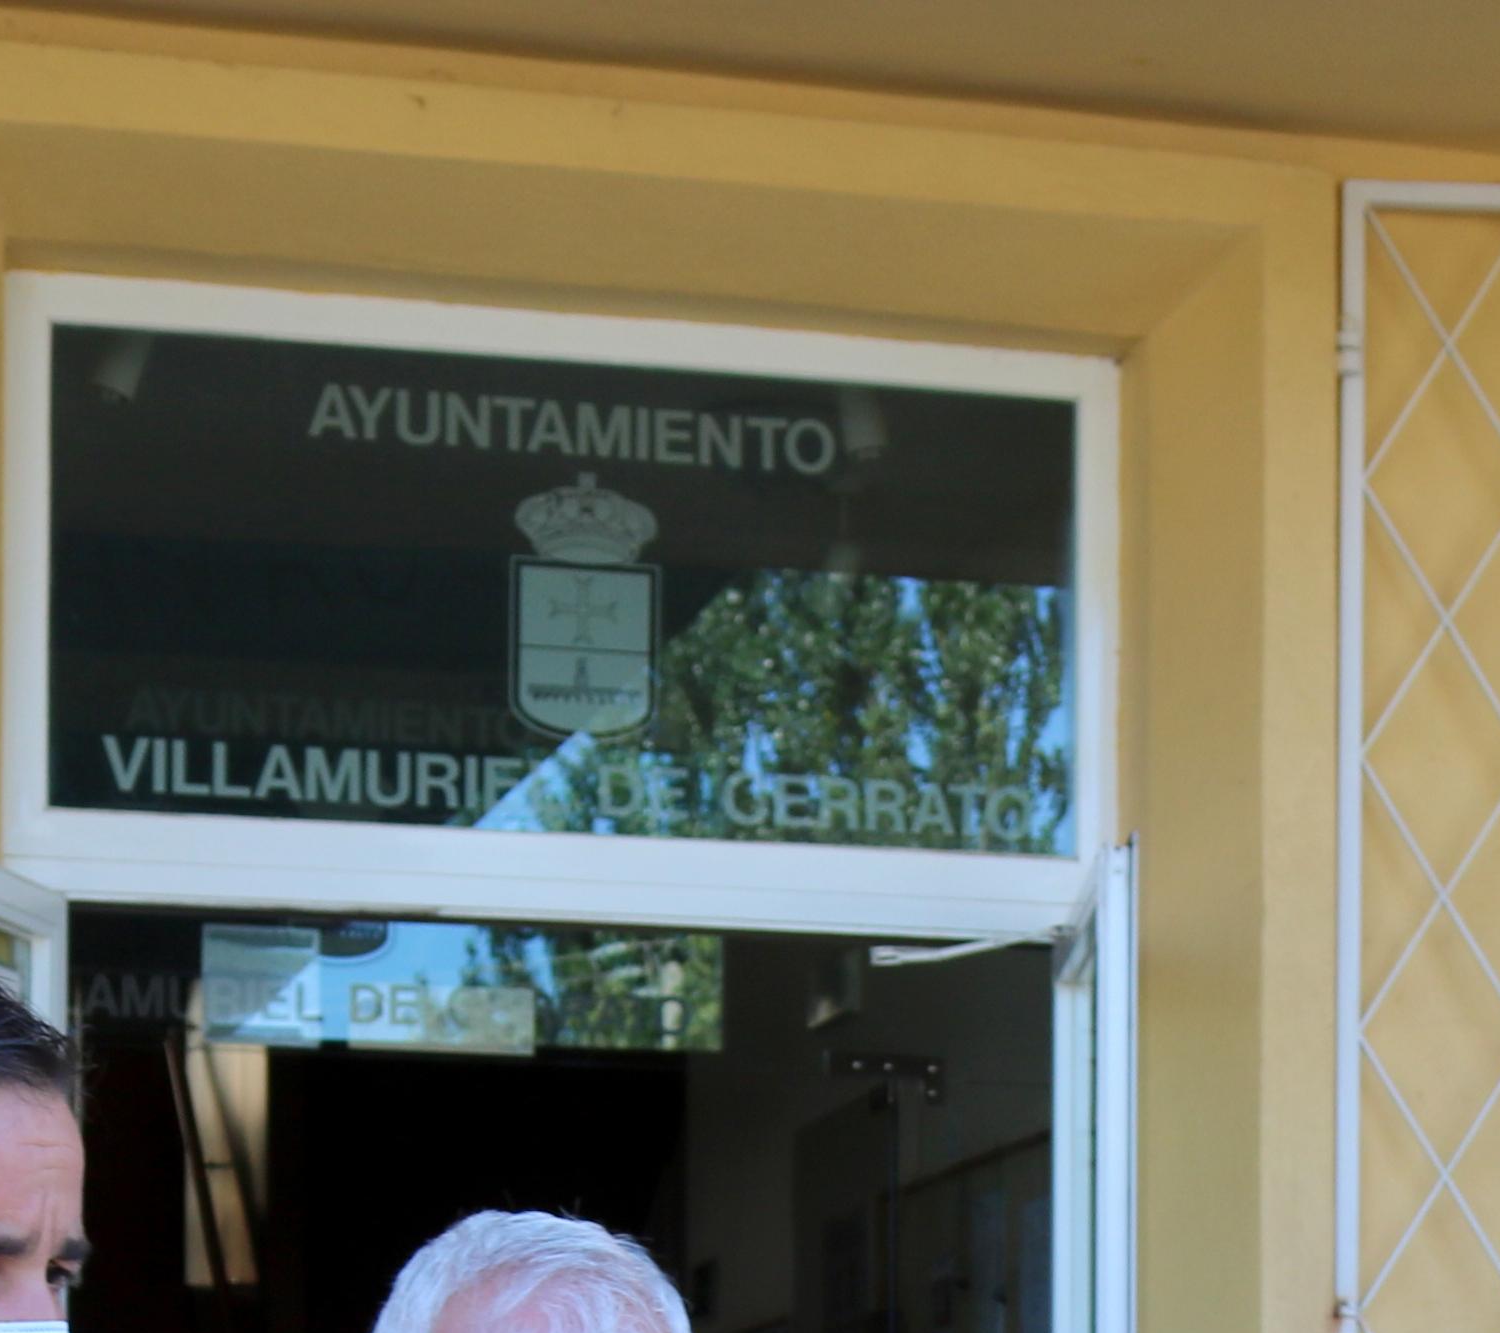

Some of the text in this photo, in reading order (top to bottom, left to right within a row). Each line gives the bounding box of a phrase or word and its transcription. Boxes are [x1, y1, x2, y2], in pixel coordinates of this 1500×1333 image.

[308, 383, 836, 478] AYUNTAMIENTO
[101, 732, 1034, 842] VILLAMURIE DE CERRATO
[74, 971, 325, 1024] AMURIEL
[348, 981, 421, 1026] DE
